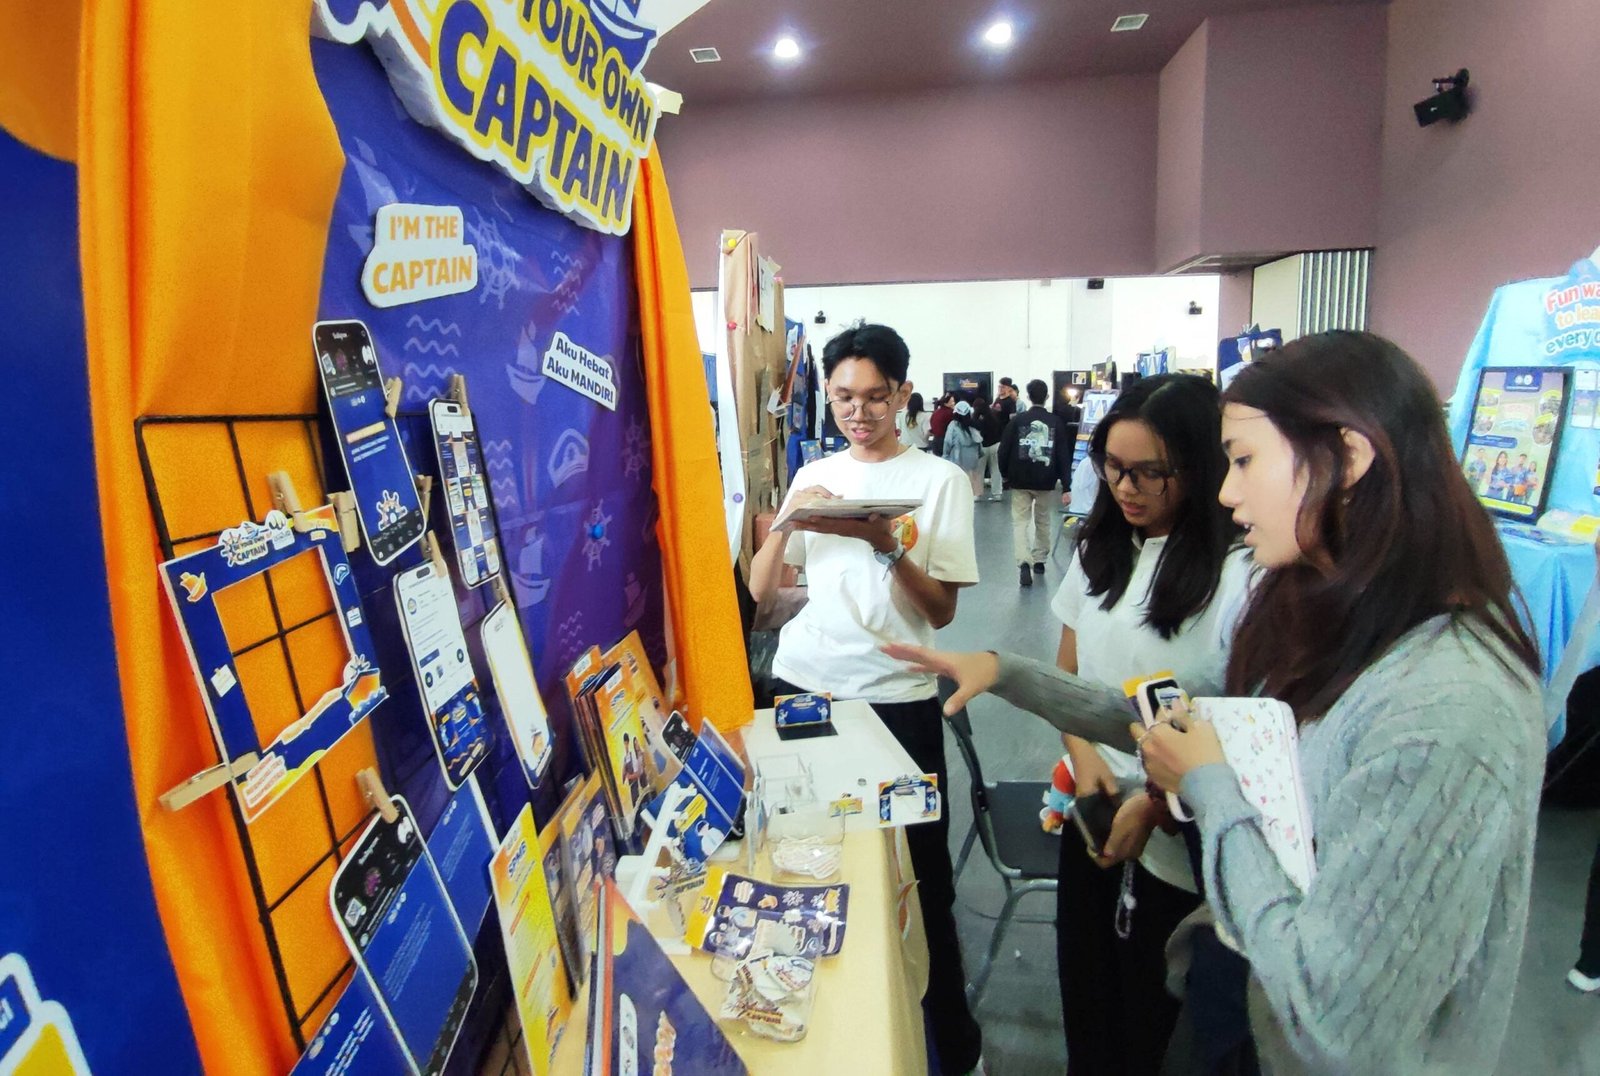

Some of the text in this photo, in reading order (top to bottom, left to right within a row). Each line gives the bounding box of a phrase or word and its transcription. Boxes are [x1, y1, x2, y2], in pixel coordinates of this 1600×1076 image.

[438, 0, 632, 223] CAPTAIN
[603, 58, 650, 143] OWN
[390, 215, 458, 241] I'M THE
[373, 255, 473, 294] CAPTAIN
[1546, 287, 1580, 313] Fun
[1557, 311, 1574, 327] to
[1546, 331, 1591, 353] every
[556, 338, 609, 379] Aku Hebat
[547, 357, 614, 403] Aku MANDIRI
[236, 543, 266, 561] CAPTAIN
